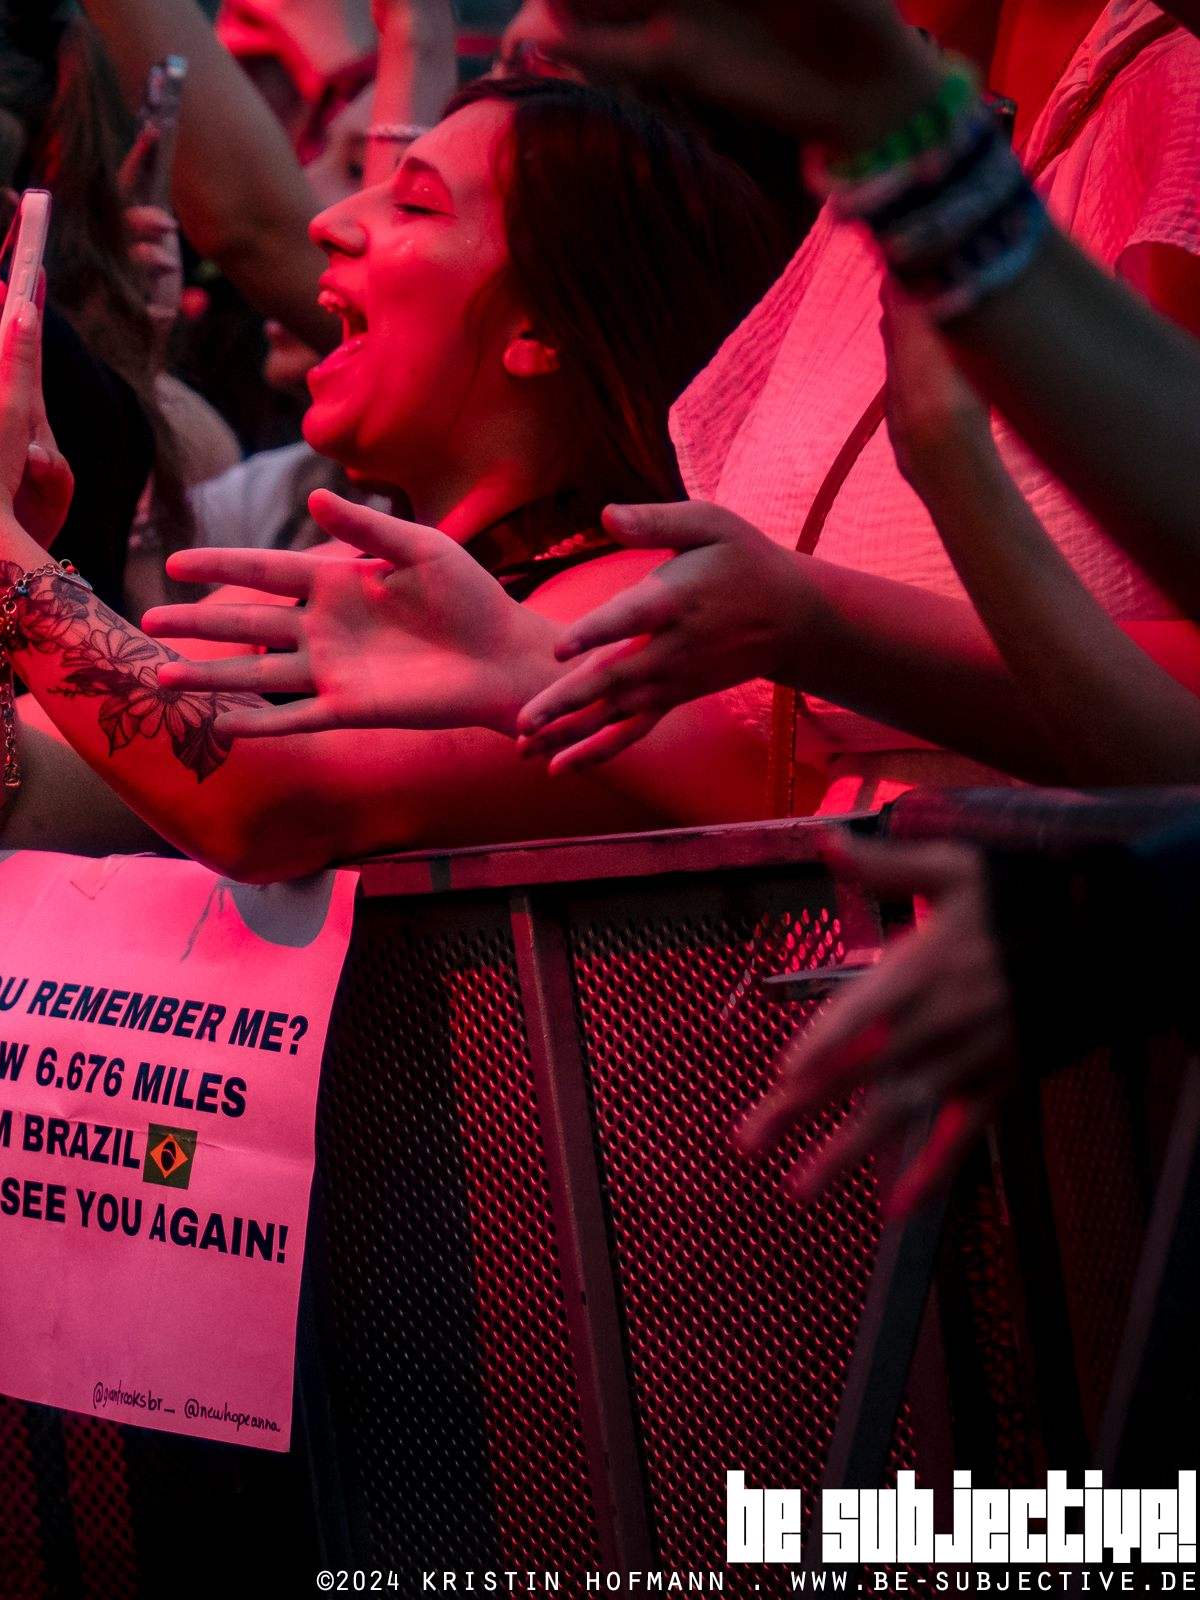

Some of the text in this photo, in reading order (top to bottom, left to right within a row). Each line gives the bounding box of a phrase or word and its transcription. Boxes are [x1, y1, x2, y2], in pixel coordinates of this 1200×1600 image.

[26, 980, 227, 1042] REMEMBER
[228, 1007, 309, 1056] ME?
[35, 1047, 125, 1097] 6.676
[131, 1062, 247, 1118] MILES
[22, 1114, 141, 1170] BRAZIL
[0, 1177, 67, 1223] SEE
[76, 1188, 143, 1237] YOU
[148, 1203, 289, 1264] AGAIN!
